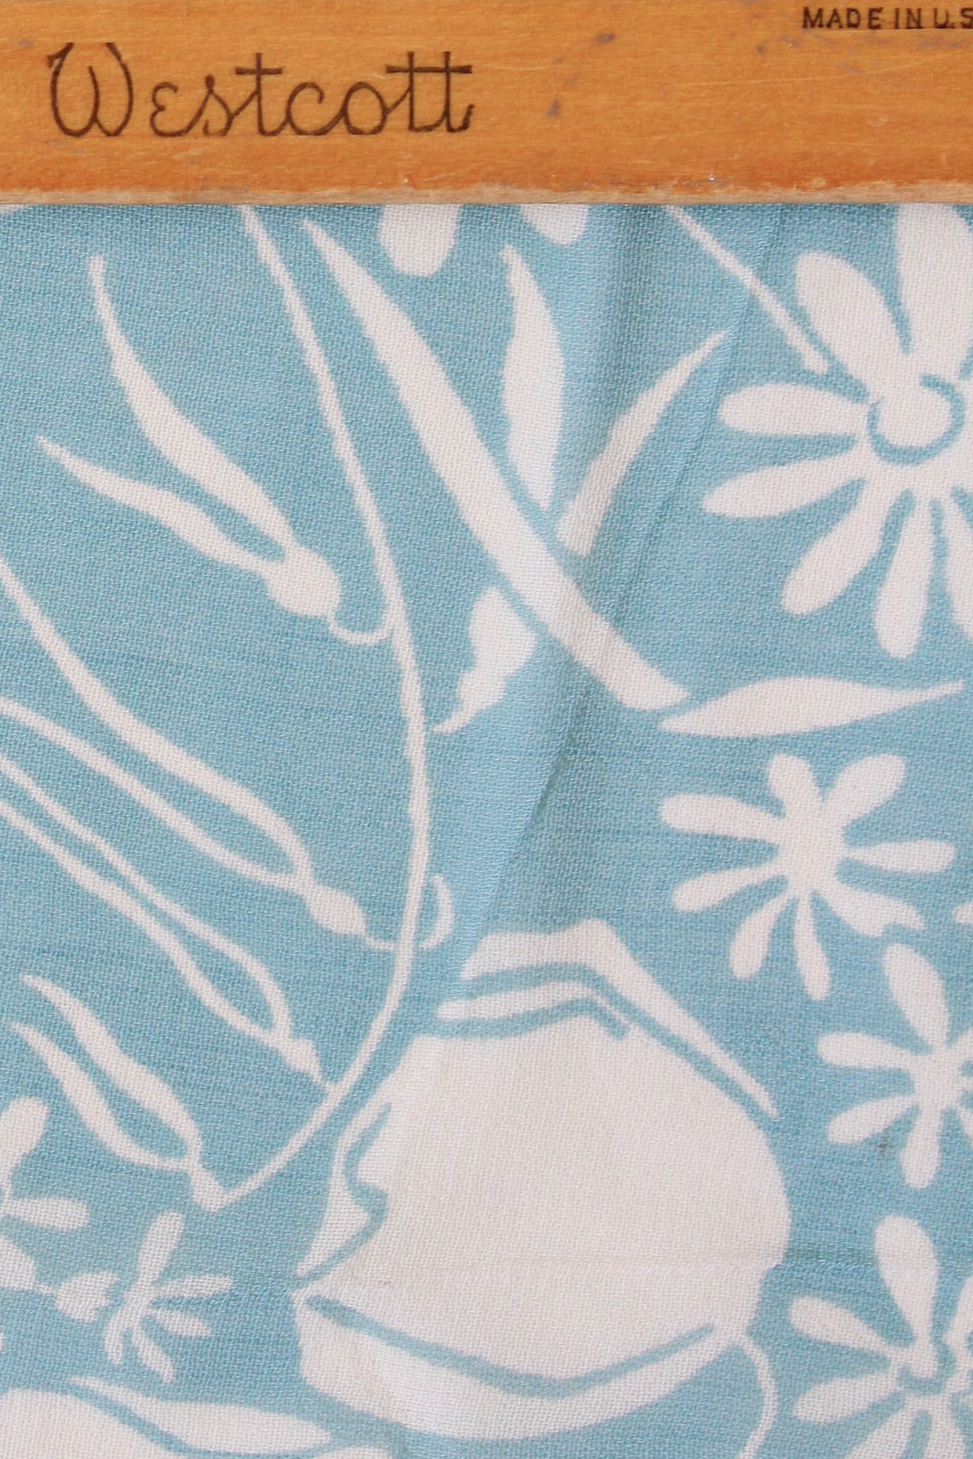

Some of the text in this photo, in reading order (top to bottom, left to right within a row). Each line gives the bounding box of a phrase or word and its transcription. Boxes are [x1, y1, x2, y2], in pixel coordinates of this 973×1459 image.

[802, 6, 884, 30] MADE
[894, 7, 923, 30] IN
[46, 40, 475, 138] Westcott
